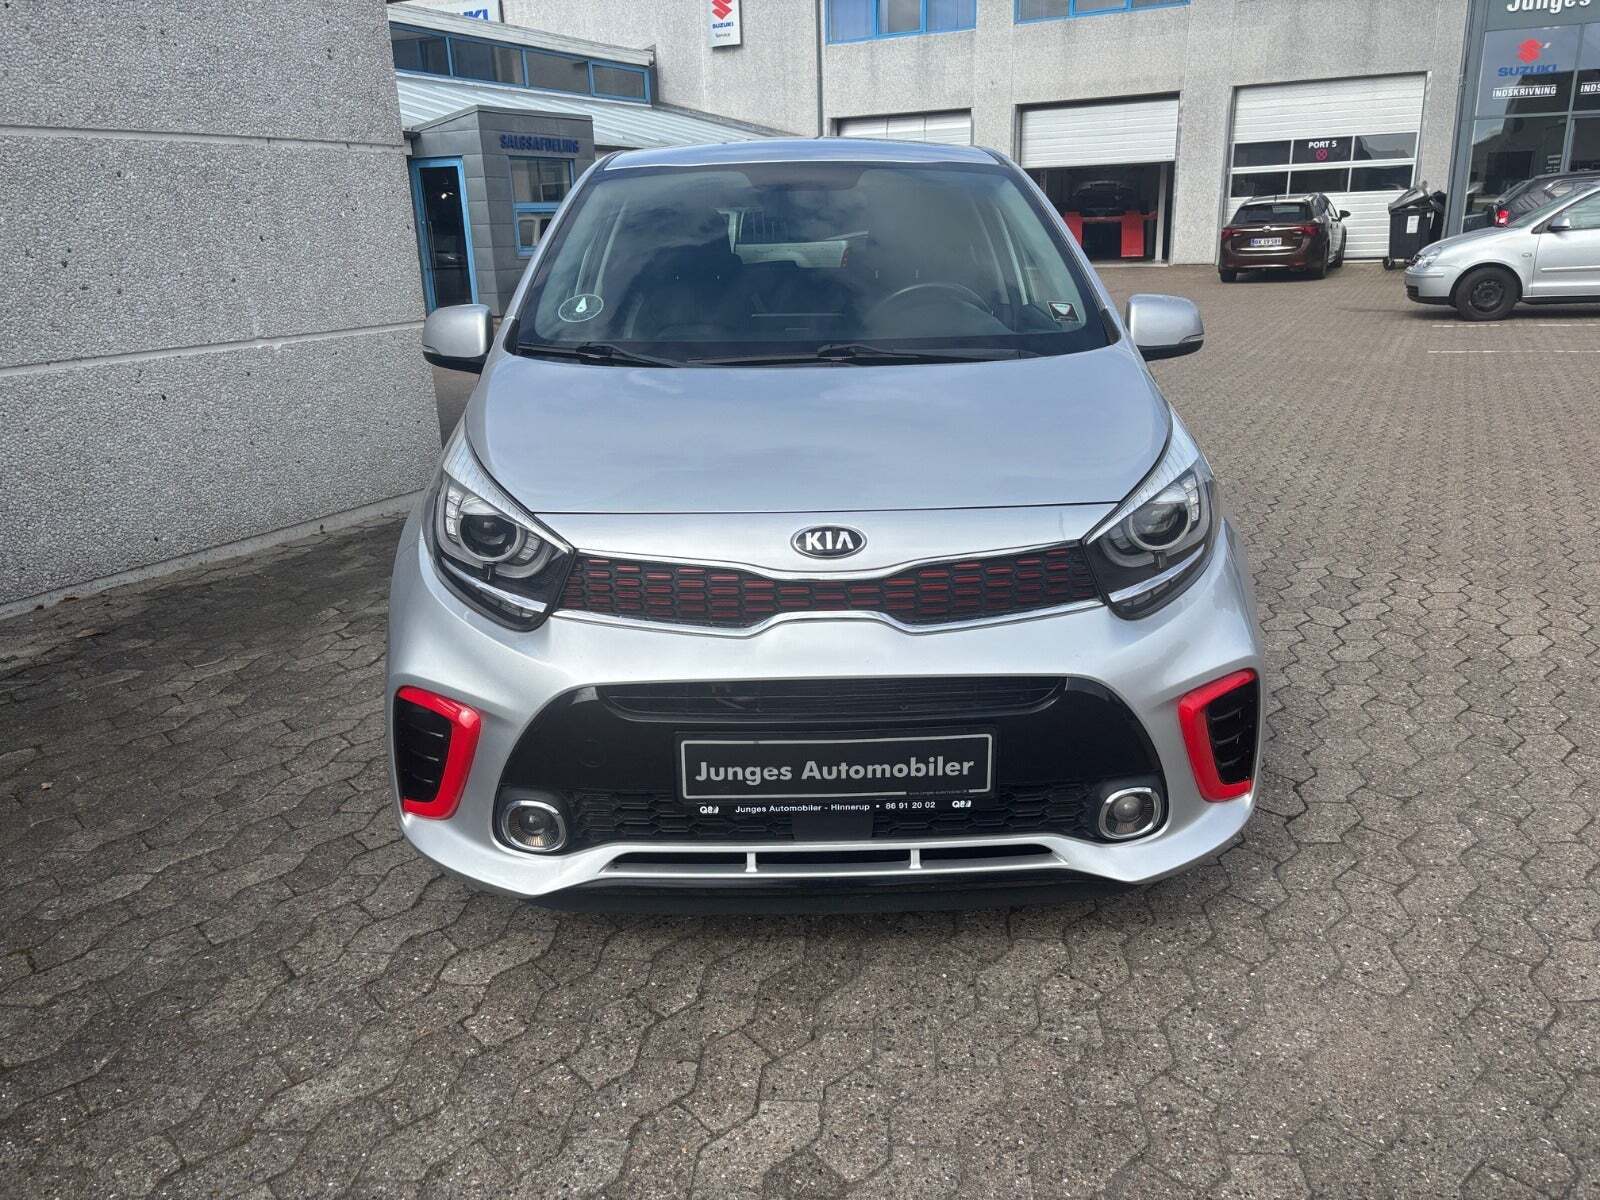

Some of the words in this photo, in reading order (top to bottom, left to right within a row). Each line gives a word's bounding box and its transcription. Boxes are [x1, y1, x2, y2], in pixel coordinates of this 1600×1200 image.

[712, 21, 734, 29] SUZUKI
[1498, 64, 1557, 77] SUZUKI
[1492, 86, 1557, 97] INDSKRIVNING
[1308, 140, 1330, 149] PORT
[1331, 140, 1337, 148] 5
[805, 531, 855, 551] KIA
[695, 761, 793, 786] Junges
[801, 755, 975, 780] Automobiler
[735, 805, 767, 814] Junges
[769, 804, 821, 813] Automobiler
[830, 803, 870, 811] Hinnerup
[885, 802, 896, 810] 86
[912, 801, 922, 809] 20
